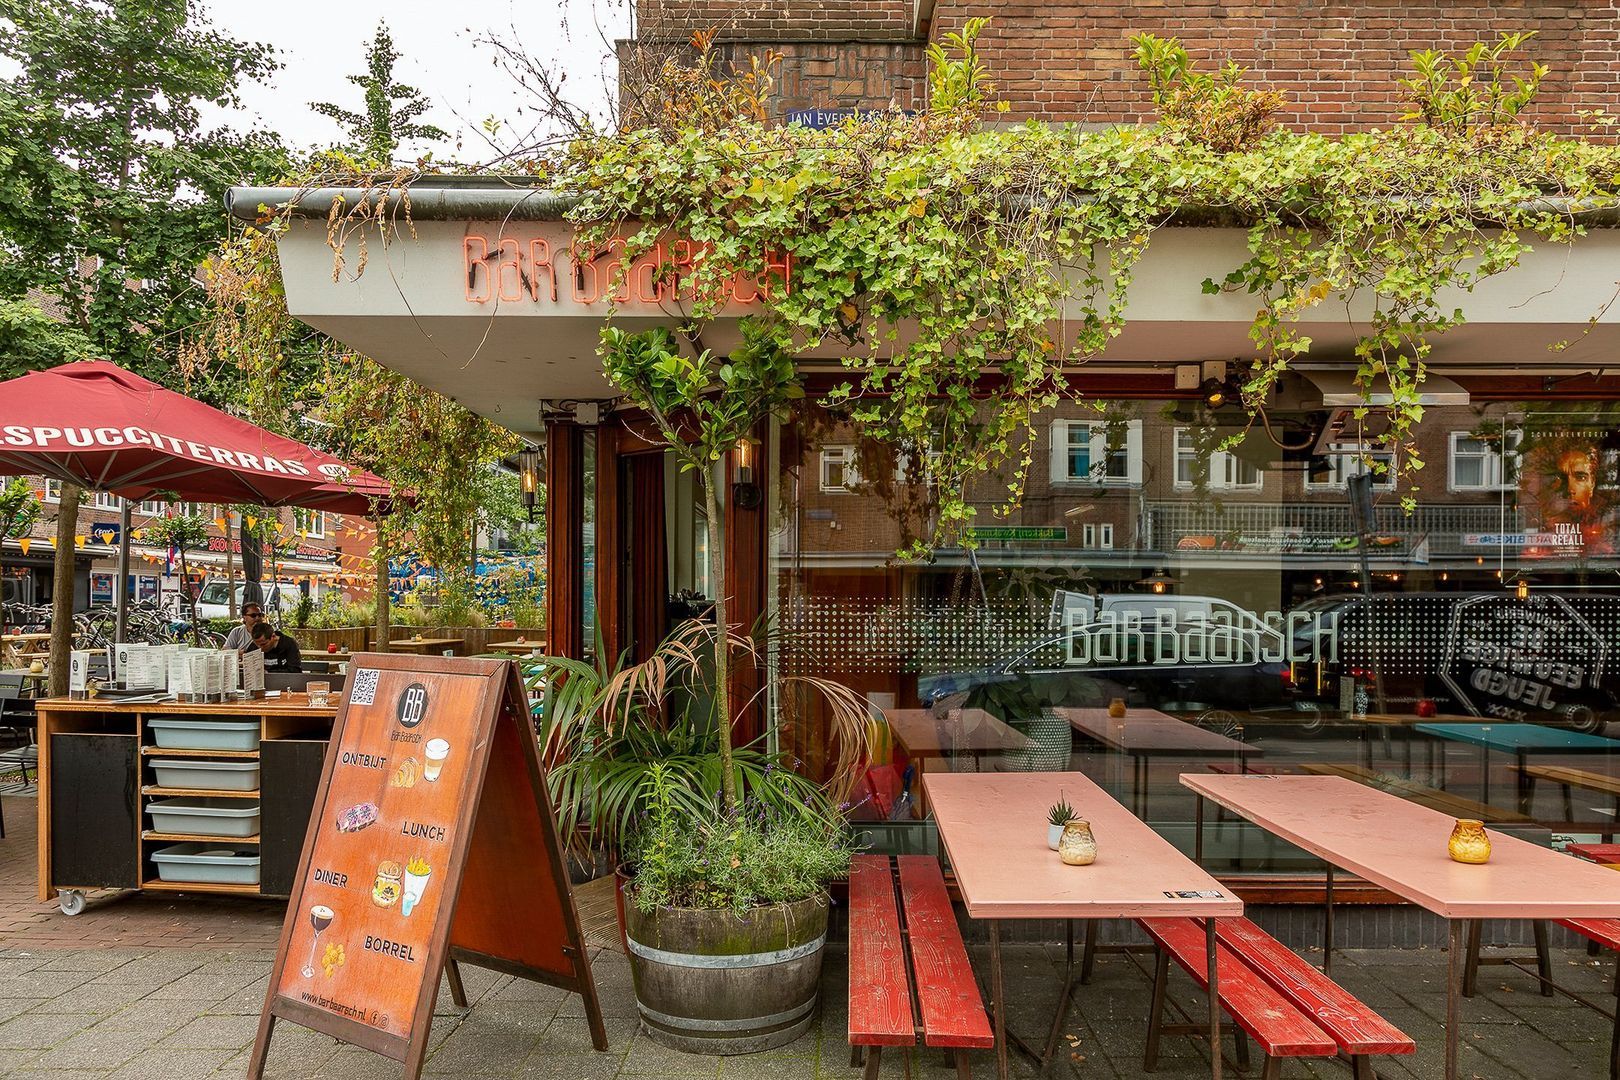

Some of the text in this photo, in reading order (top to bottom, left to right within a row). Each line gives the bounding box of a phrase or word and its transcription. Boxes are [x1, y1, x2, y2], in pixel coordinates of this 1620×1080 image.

[0, 425, 310, 476] SPUCCITERRAS
[1554, 523, 1582, 534] TOTAL
[1552, 534, 1585, 546] RECALL
[401, 687, 425, 723] BB
[342, 752, 387, 769] ONTBIJT
[402, 821, 446, 841] LUNCH
[314, 868, 348, 888] DINER
[364, 935, 415, 961] BORREL
